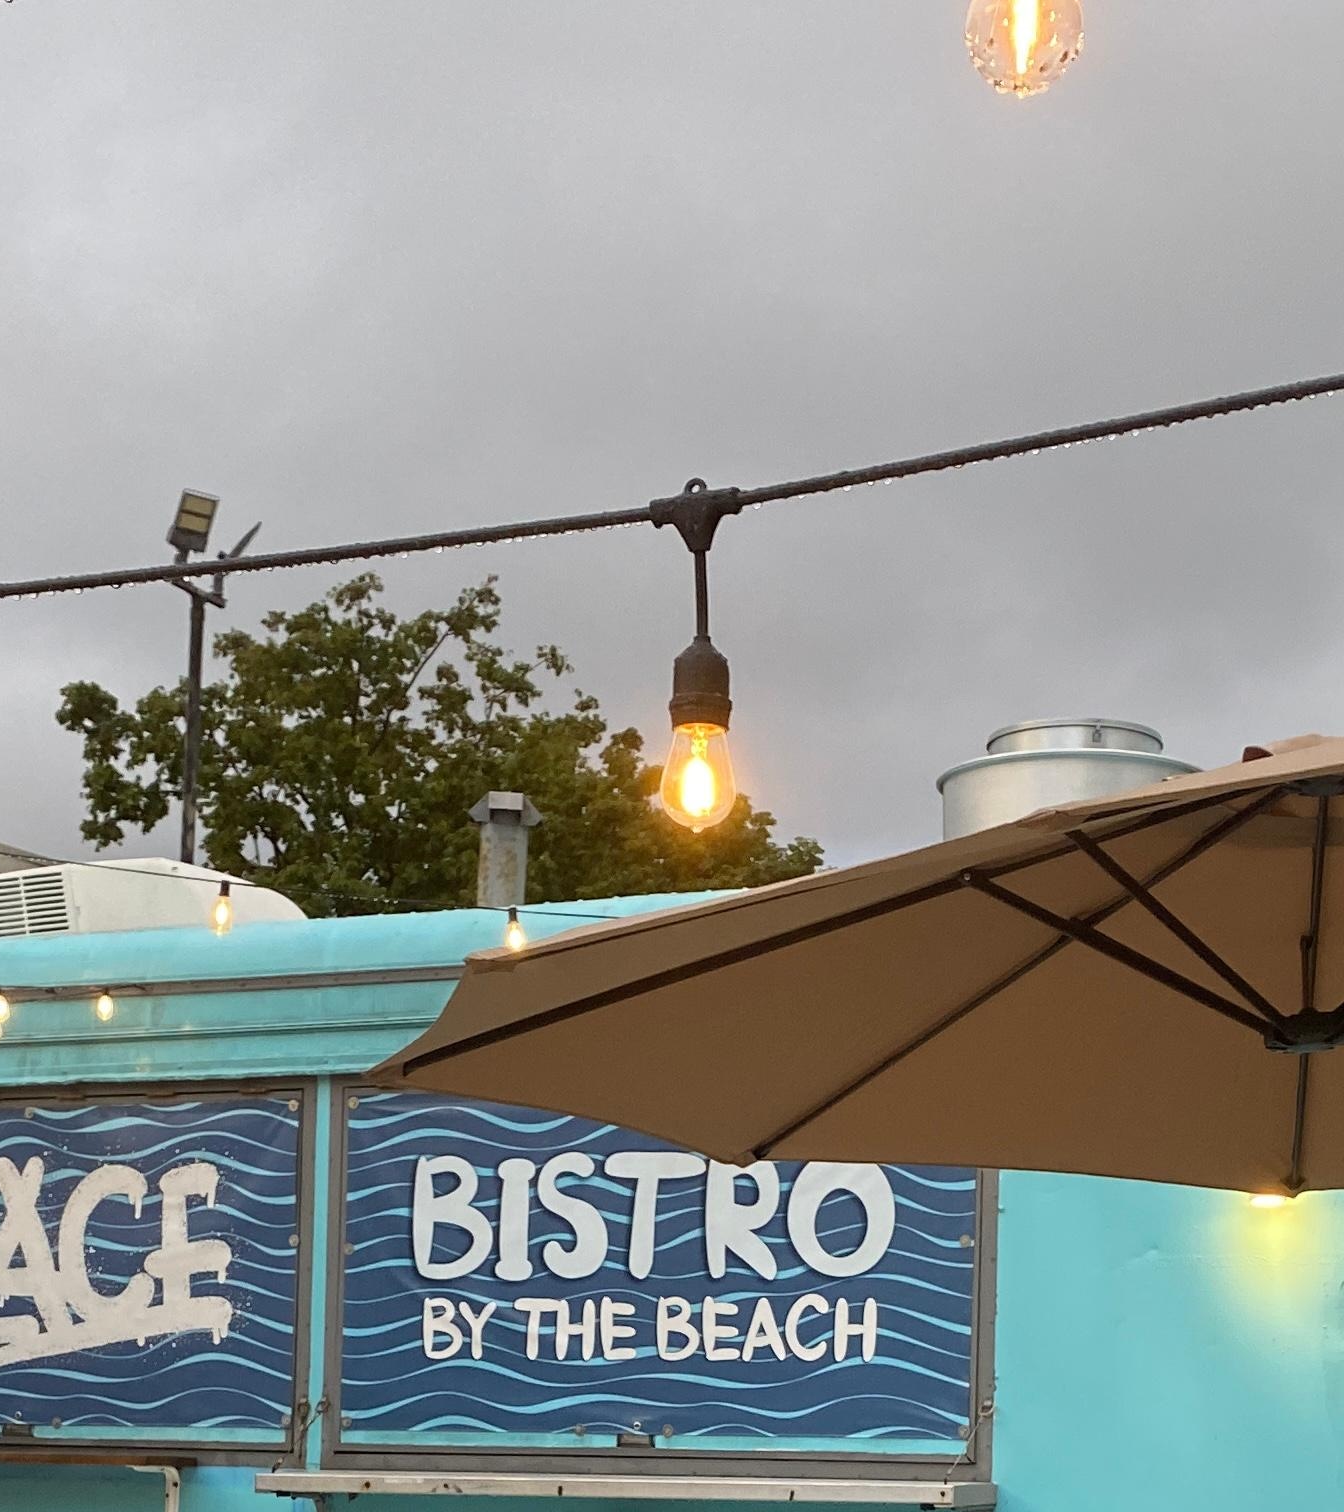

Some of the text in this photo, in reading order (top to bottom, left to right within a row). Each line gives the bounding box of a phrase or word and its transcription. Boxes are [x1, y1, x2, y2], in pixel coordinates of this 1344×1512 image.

[412, 1151, 896, 1281] BISTRO
[423, 1293, 878, 1362] BY THE BEACH
